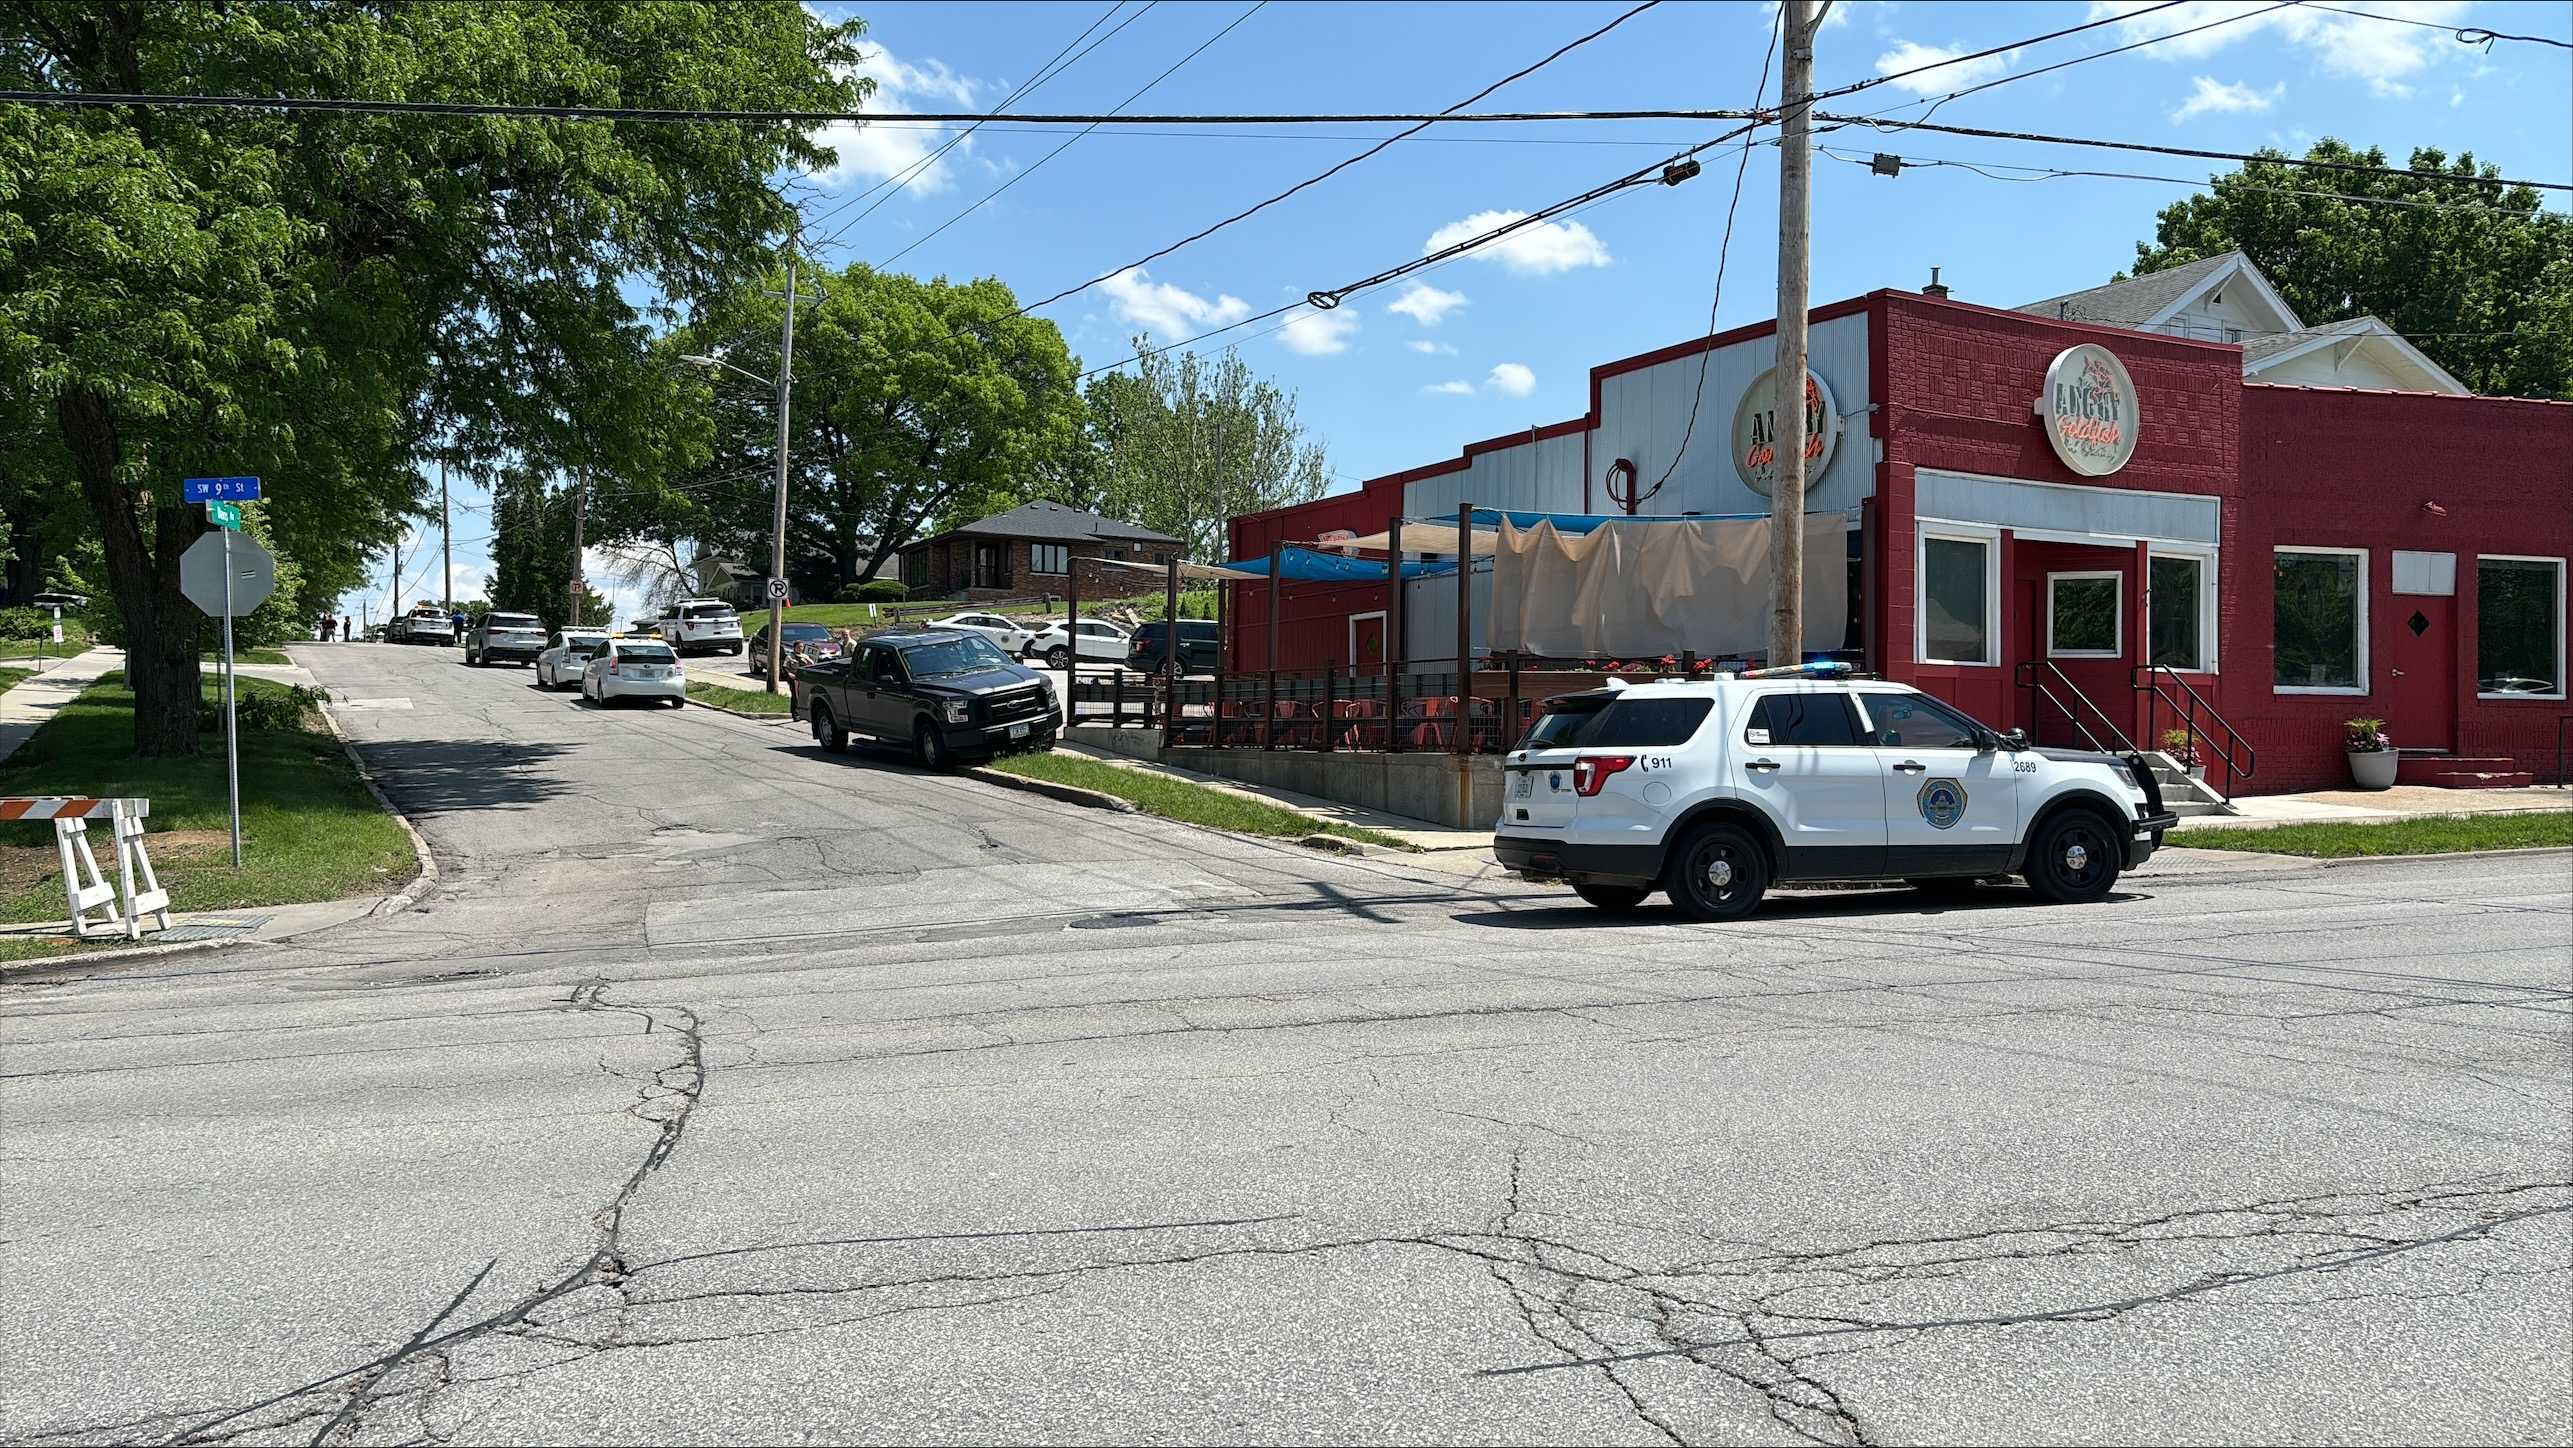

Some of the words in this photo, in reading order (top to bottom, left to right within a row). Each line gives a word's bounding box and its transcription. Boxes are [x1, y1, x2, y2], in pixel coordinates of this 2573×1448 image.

[2056, 383, 2120, 422] ANGRY
[2057, 415, 2122, 449] Goldfish
[197, 483, 209, 494] SW
[235, 482, 245, 493] St
[1652, 757, 1672, 769] 911
[2013, 761, 2037, 773] 2689
